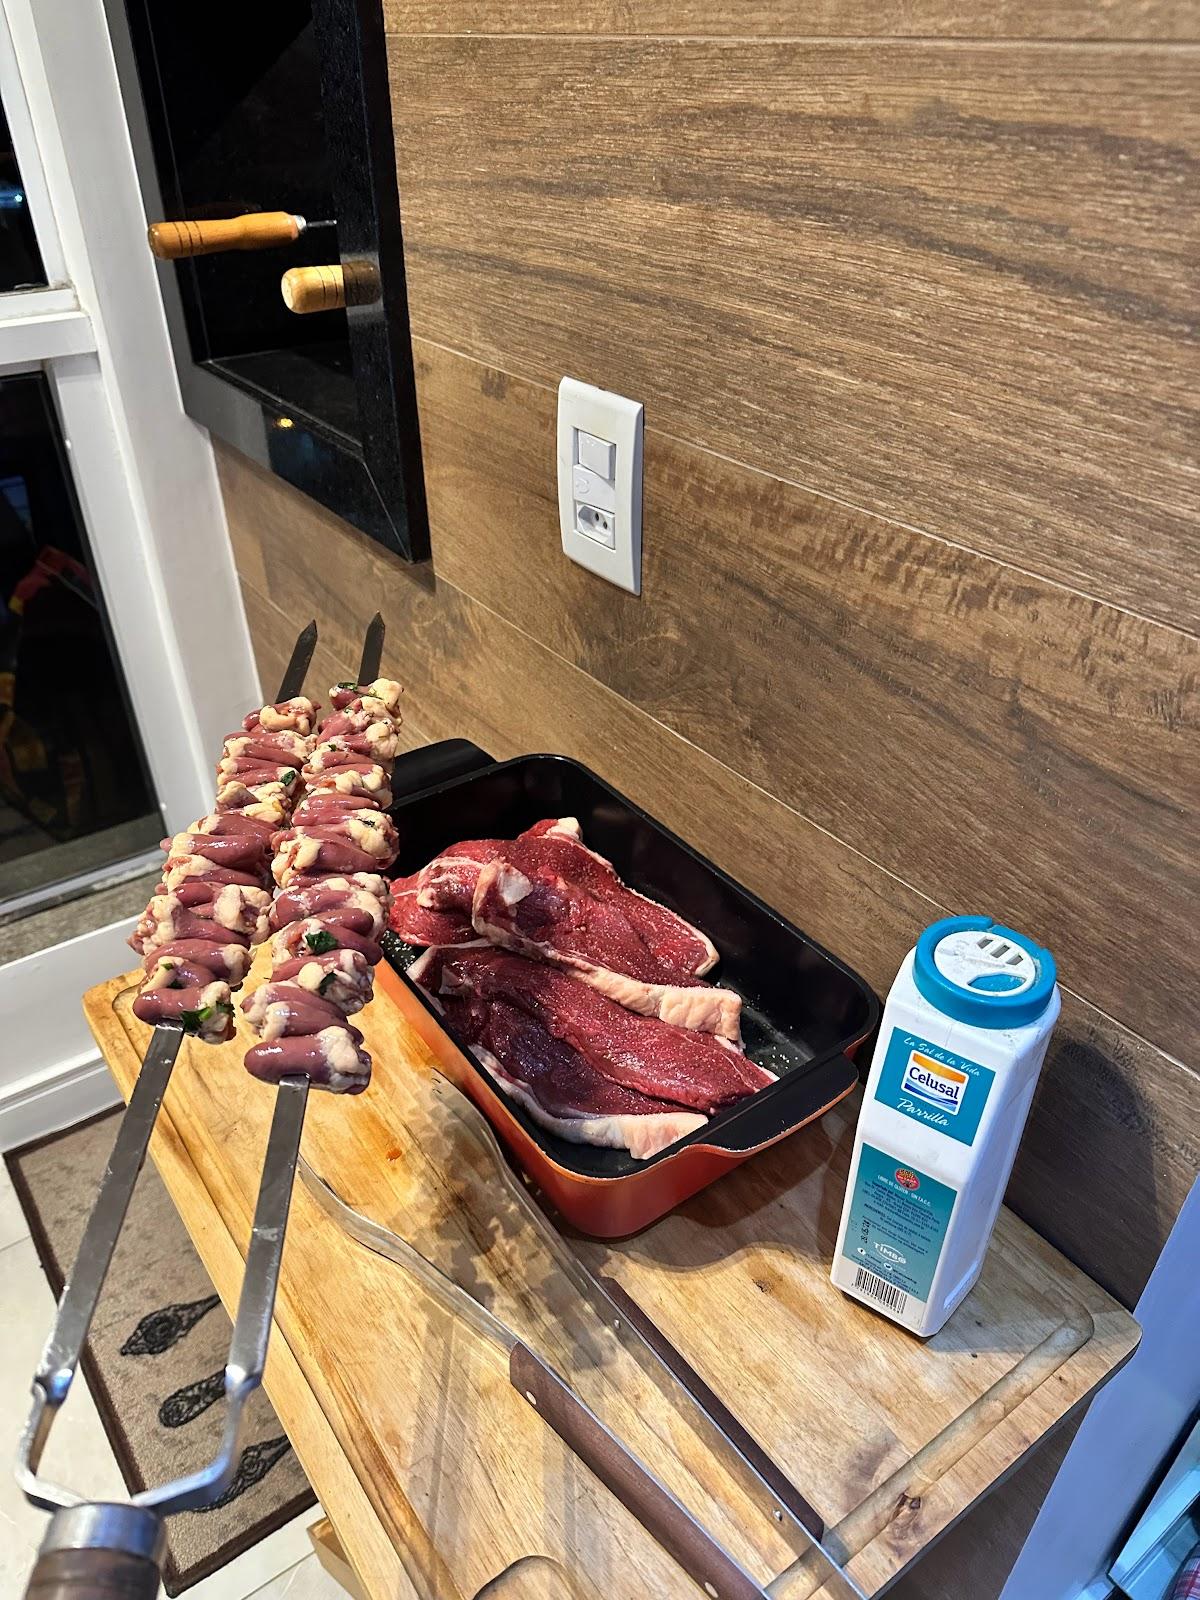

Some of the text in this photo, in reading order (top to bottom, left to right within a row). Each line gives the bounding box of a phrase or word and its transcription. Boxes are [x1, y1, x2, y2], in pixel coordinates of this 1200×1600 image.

[903, 1037, 915, 1047] La
[919, 1043, 935, 1055] Sal
[935, 1052, 945, 1061] de
[960, 1061, 980, 1077] Vida
[909, 1066, 960, 1100] Celusal
[896, 1097, 950, 1127] Parrilla
